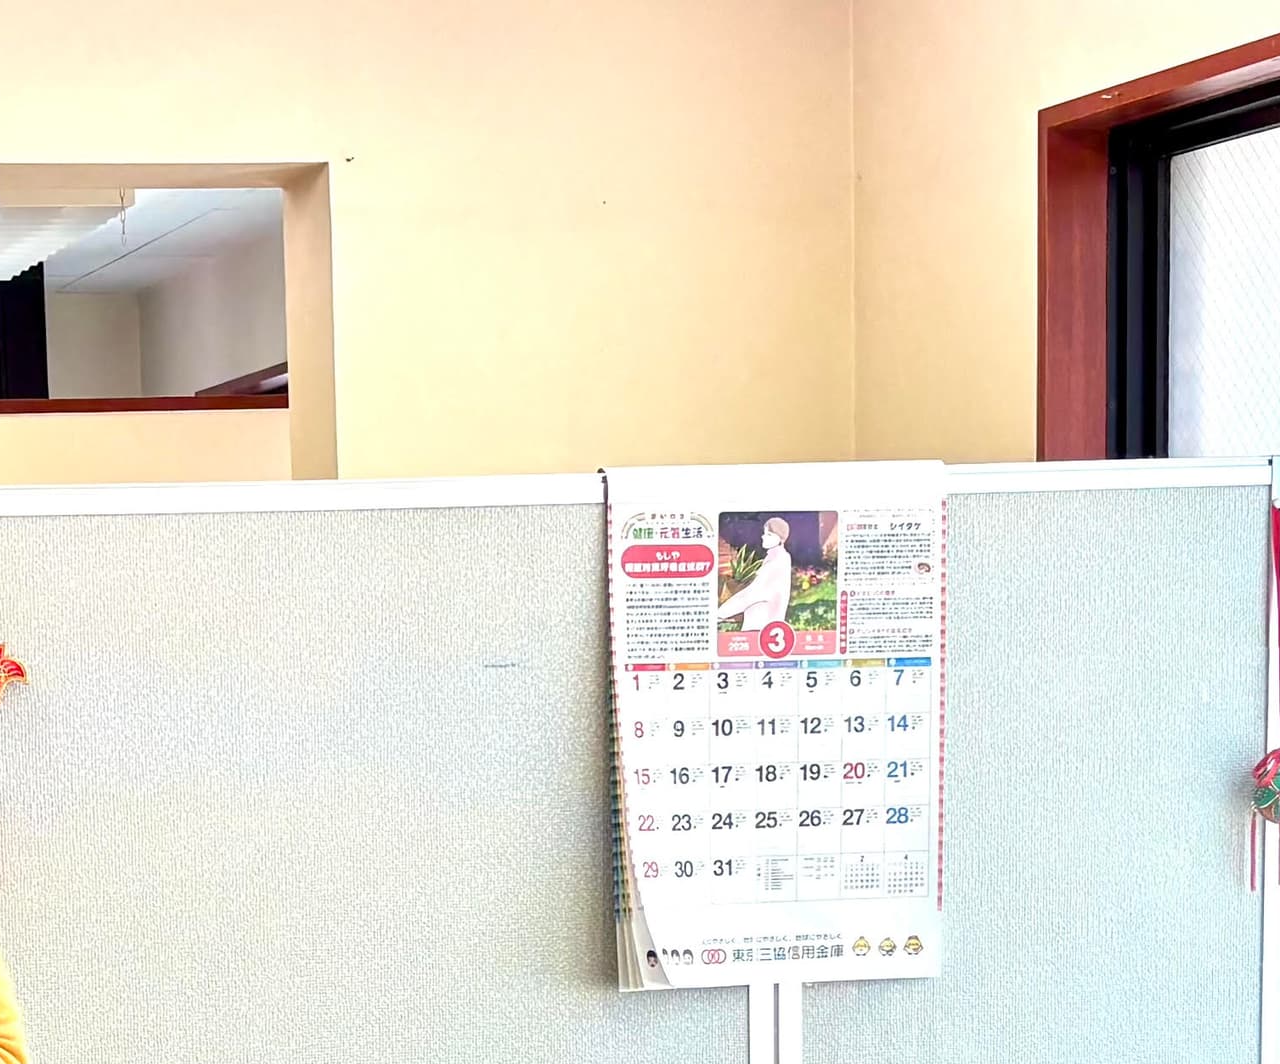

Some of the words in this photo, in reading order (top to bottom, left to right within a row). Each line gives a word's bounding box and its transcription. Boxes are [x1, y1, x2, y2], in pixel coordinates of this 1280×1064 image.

[767, 627, 786, 653] 3
[632, 673, 641, 691] 1
[672, 672, 685, 691] 2
[716, 671, 729, 690] 3
[761, 672, 774, 689] 4
[805, 671, 818, 689] 5
[849, 671, 862, 687] 6
[893, 669, 905, 686] 7
[634, 721, 645, 739] 8
[673, 720, 685, 738] 9
[711, 718, 733, 737] 10
[757, 718, 776, 736] 11
[799, 716, 822, 735] 12
[843, 715, 865, 733] 13
[887, 714, 909, 732] 14
[634, 768, 651, 785] 15
[669, 766, 690, 785] 16
[711, 765, 733, 784] 17
[755, 764, 777, 783] 18
[799, 763, 821, 781] 19
[842, 762, 866, 780] 20
[886, 760, 908, 778] 21
[638, 814, 655, 832] 22
[671, 813, 692, 832] 23
[711, 812, 734, 830] 24
[754, 811, 778, 829] 25
[798, 809, 822, 828] 26
[841, 808, 865, 826] 27
[885, 806, 909, 825] 28
[644, 861, 659, 878] 29
[674, 860, 694, 878] 30
[713, 858, 733, 877] 31
